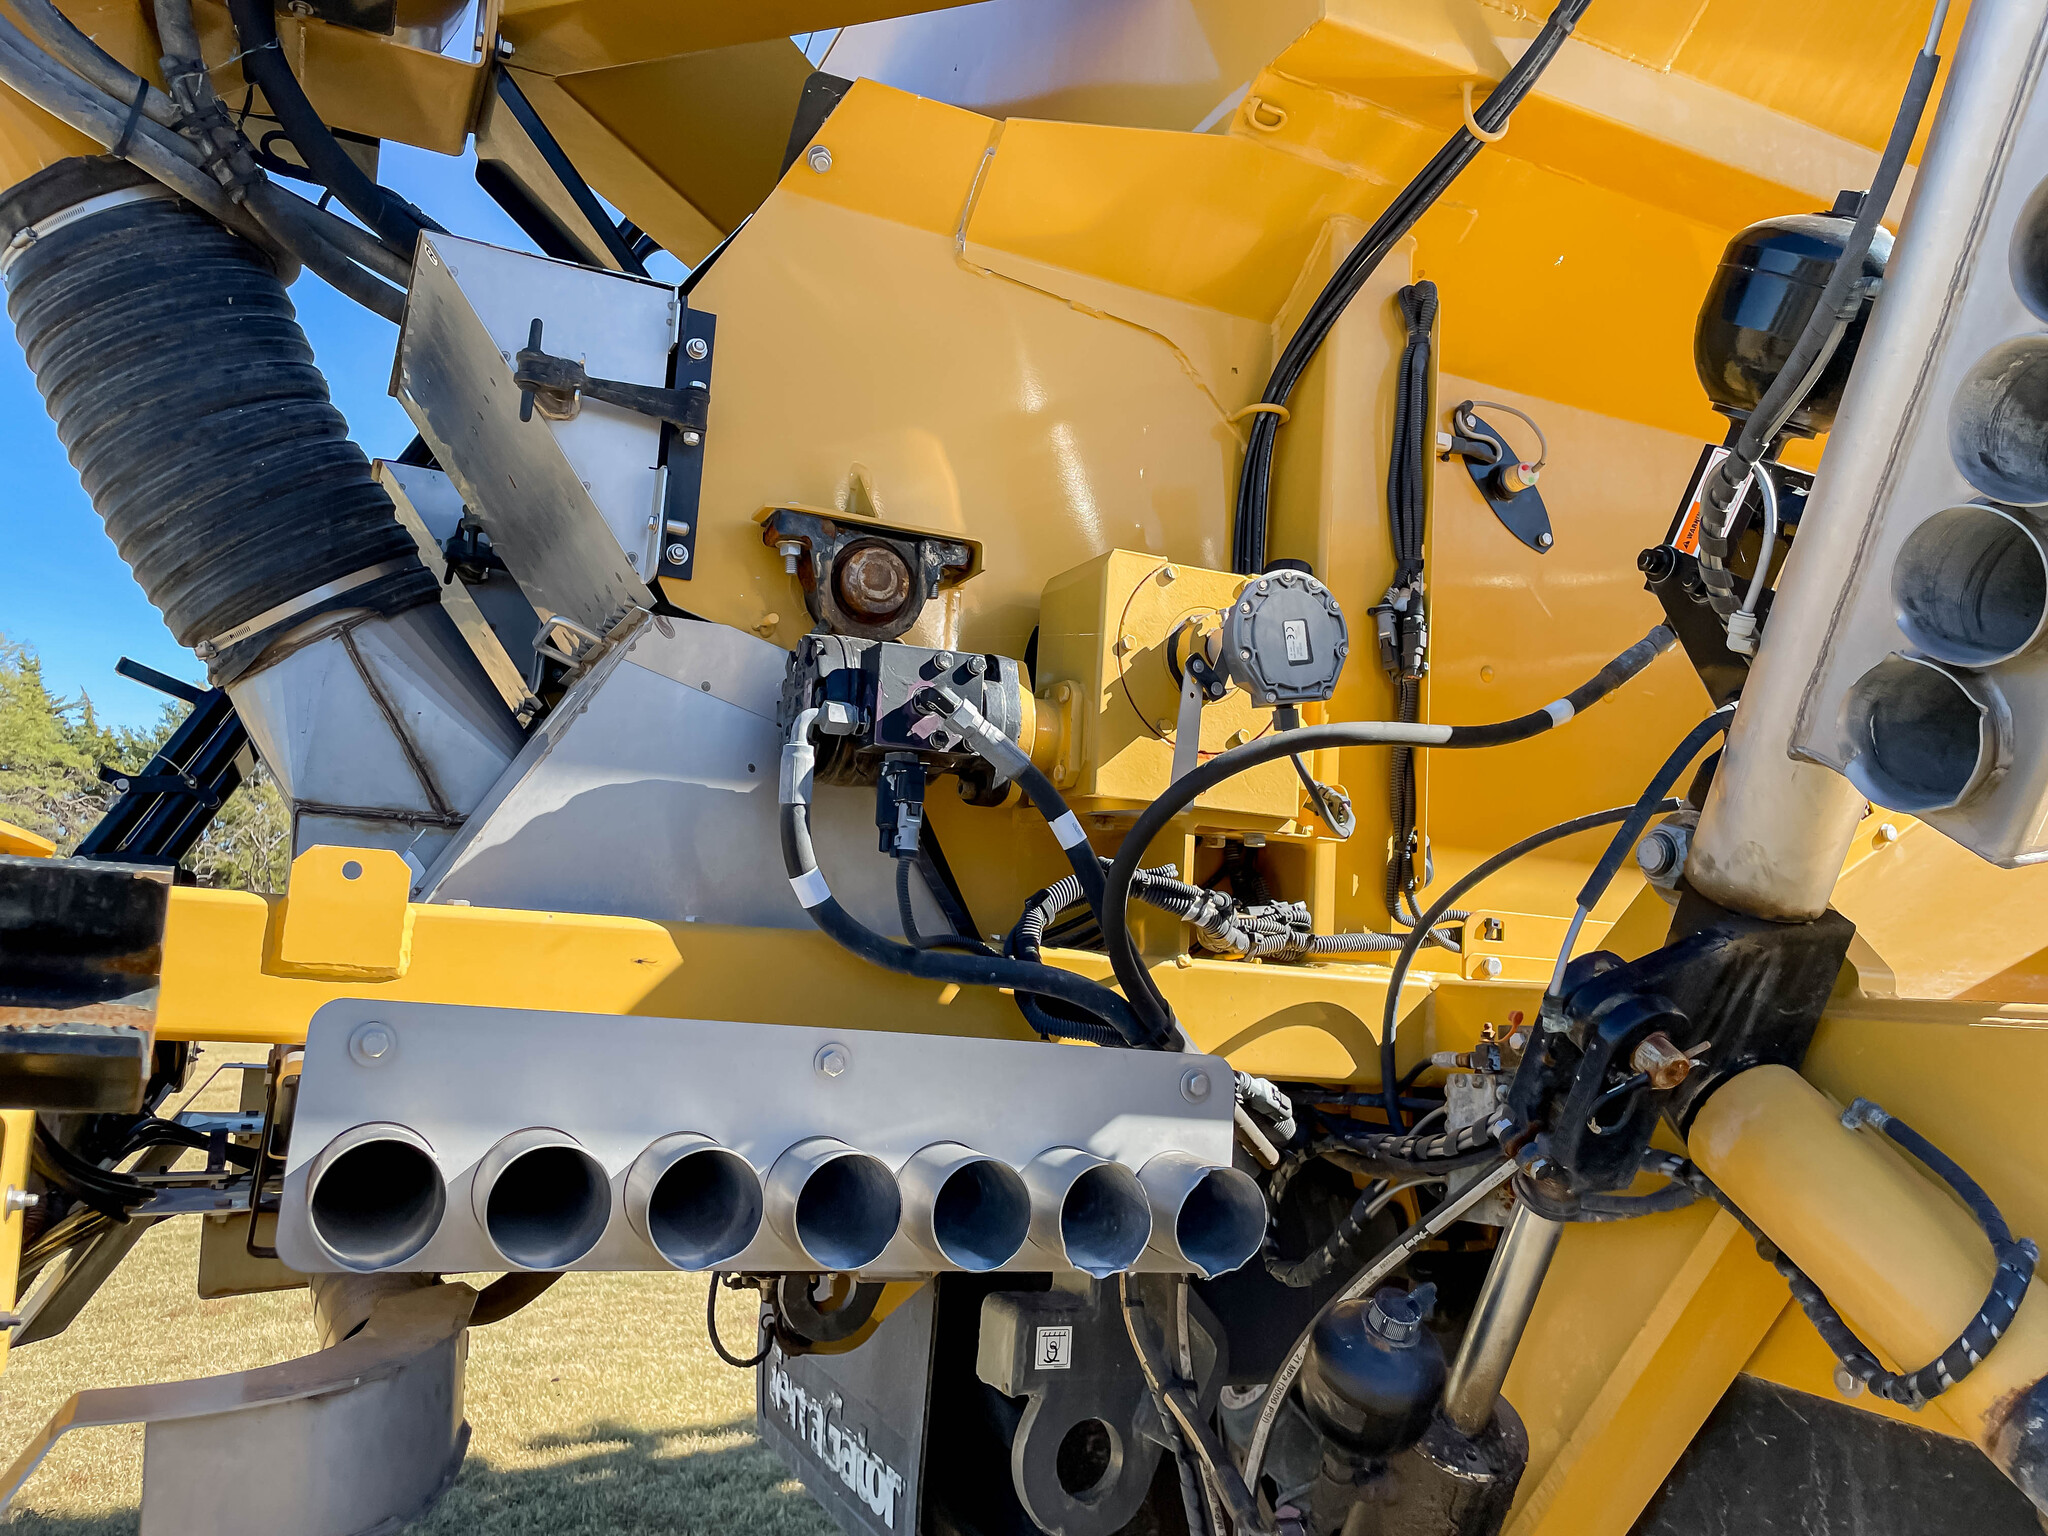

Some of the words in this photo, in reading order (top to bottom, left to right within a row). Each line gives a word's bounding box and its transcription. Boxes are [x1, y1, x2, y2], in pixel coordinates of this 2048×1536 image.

[1687, 511, 1700, 539] WARNI
[1293, 1353, 1303, 1364] 21
[1282, 1364, 1297, 1381] MPa
[1270, 1381, 1287, 1405] (3000
